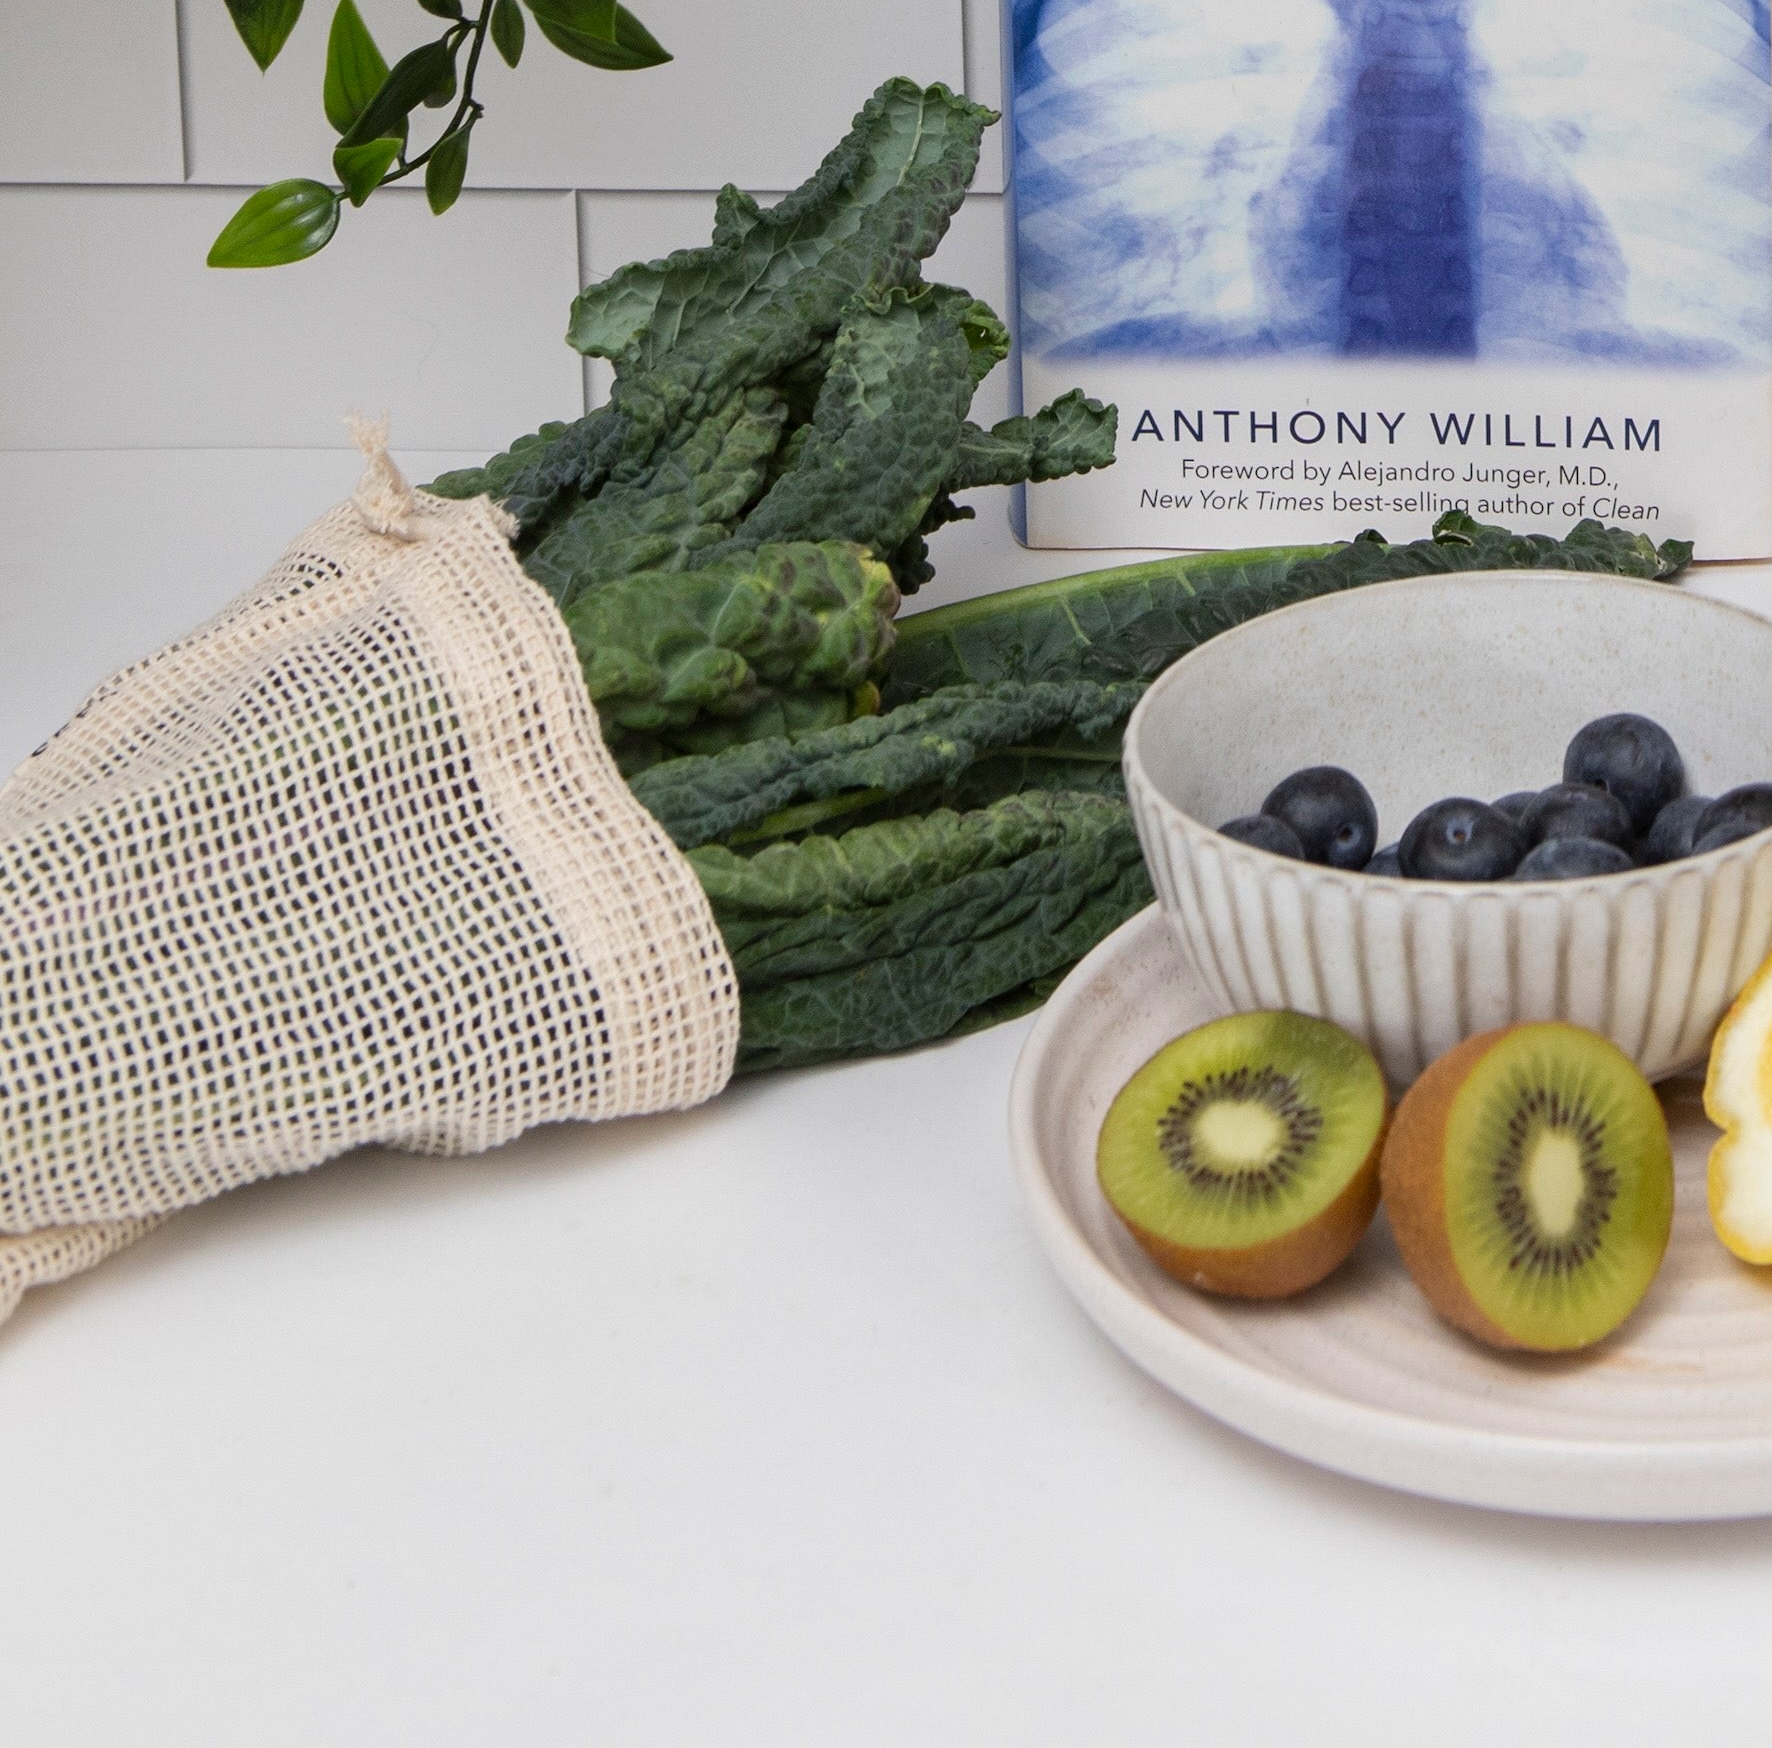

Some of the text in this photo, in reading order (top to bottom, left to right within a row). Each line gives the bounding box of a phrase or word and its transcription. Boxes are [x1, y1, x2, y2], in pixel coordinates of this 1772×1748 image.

[1131, 409, 1660, 452] ANTHONY WILLIAM
[1182, 458, 1618, 491] Foreword by Alejandro Junger, M.D.,
[1139, 488, 1660, 520] New York Times best-selling author of Clean
